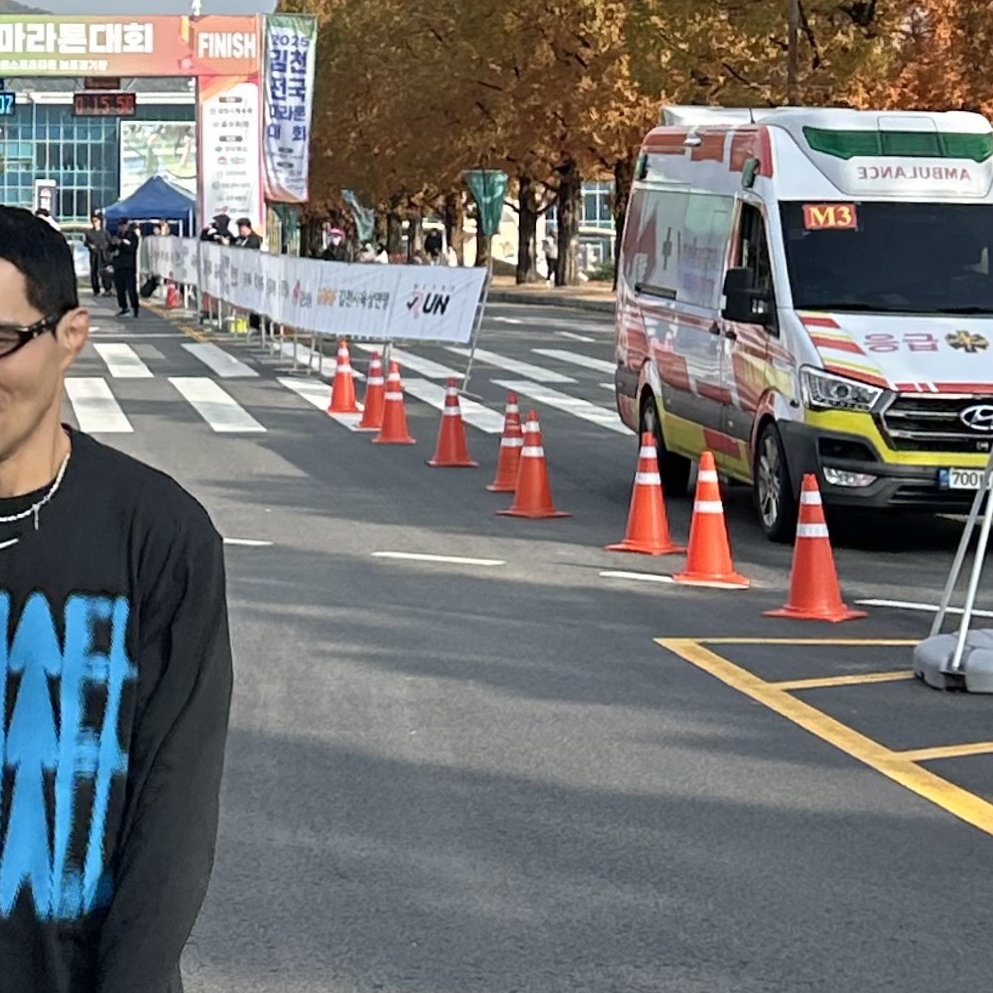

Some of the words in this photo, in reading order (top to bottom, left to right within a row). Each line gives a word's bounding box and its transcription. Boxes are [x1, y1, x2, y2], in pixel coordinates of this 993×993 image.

[198, 32, 257, 59] FINISH
[810, 204, 852, 227] M3
[864, 333, 939, 353] 응급
